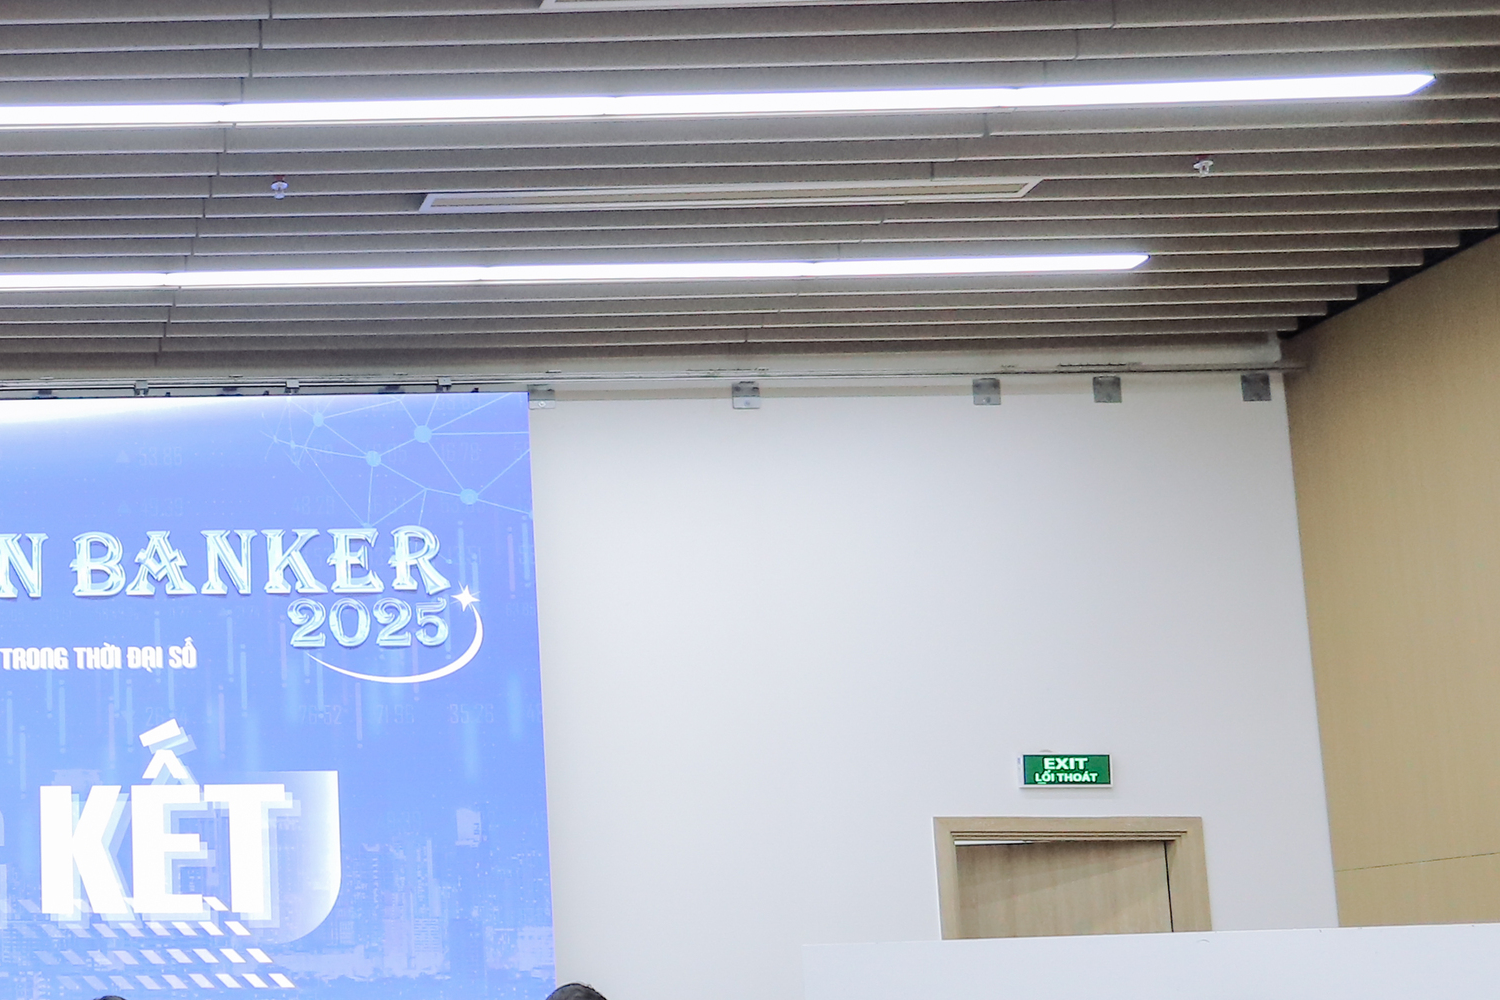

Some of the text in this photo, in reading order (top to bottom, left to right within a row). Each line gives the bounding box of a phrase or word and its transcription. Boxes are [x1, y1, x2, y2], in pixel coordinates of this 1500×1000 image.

[70, 525, 452, 597] BANKER
[287, 597, 450, 648] 2025
[0, 647, 69, 670] TRONG
[73, 641, 123, 670] THỜI
[126, 646, 164, 673] ĐẠI
[169, 636, 198, 670] SỐ
[1034, 770, 1098, 783] LỐI THOÁT
[1043, 757, 1089, 770] EXIT
[39, 718, 288, 916] KẾT
